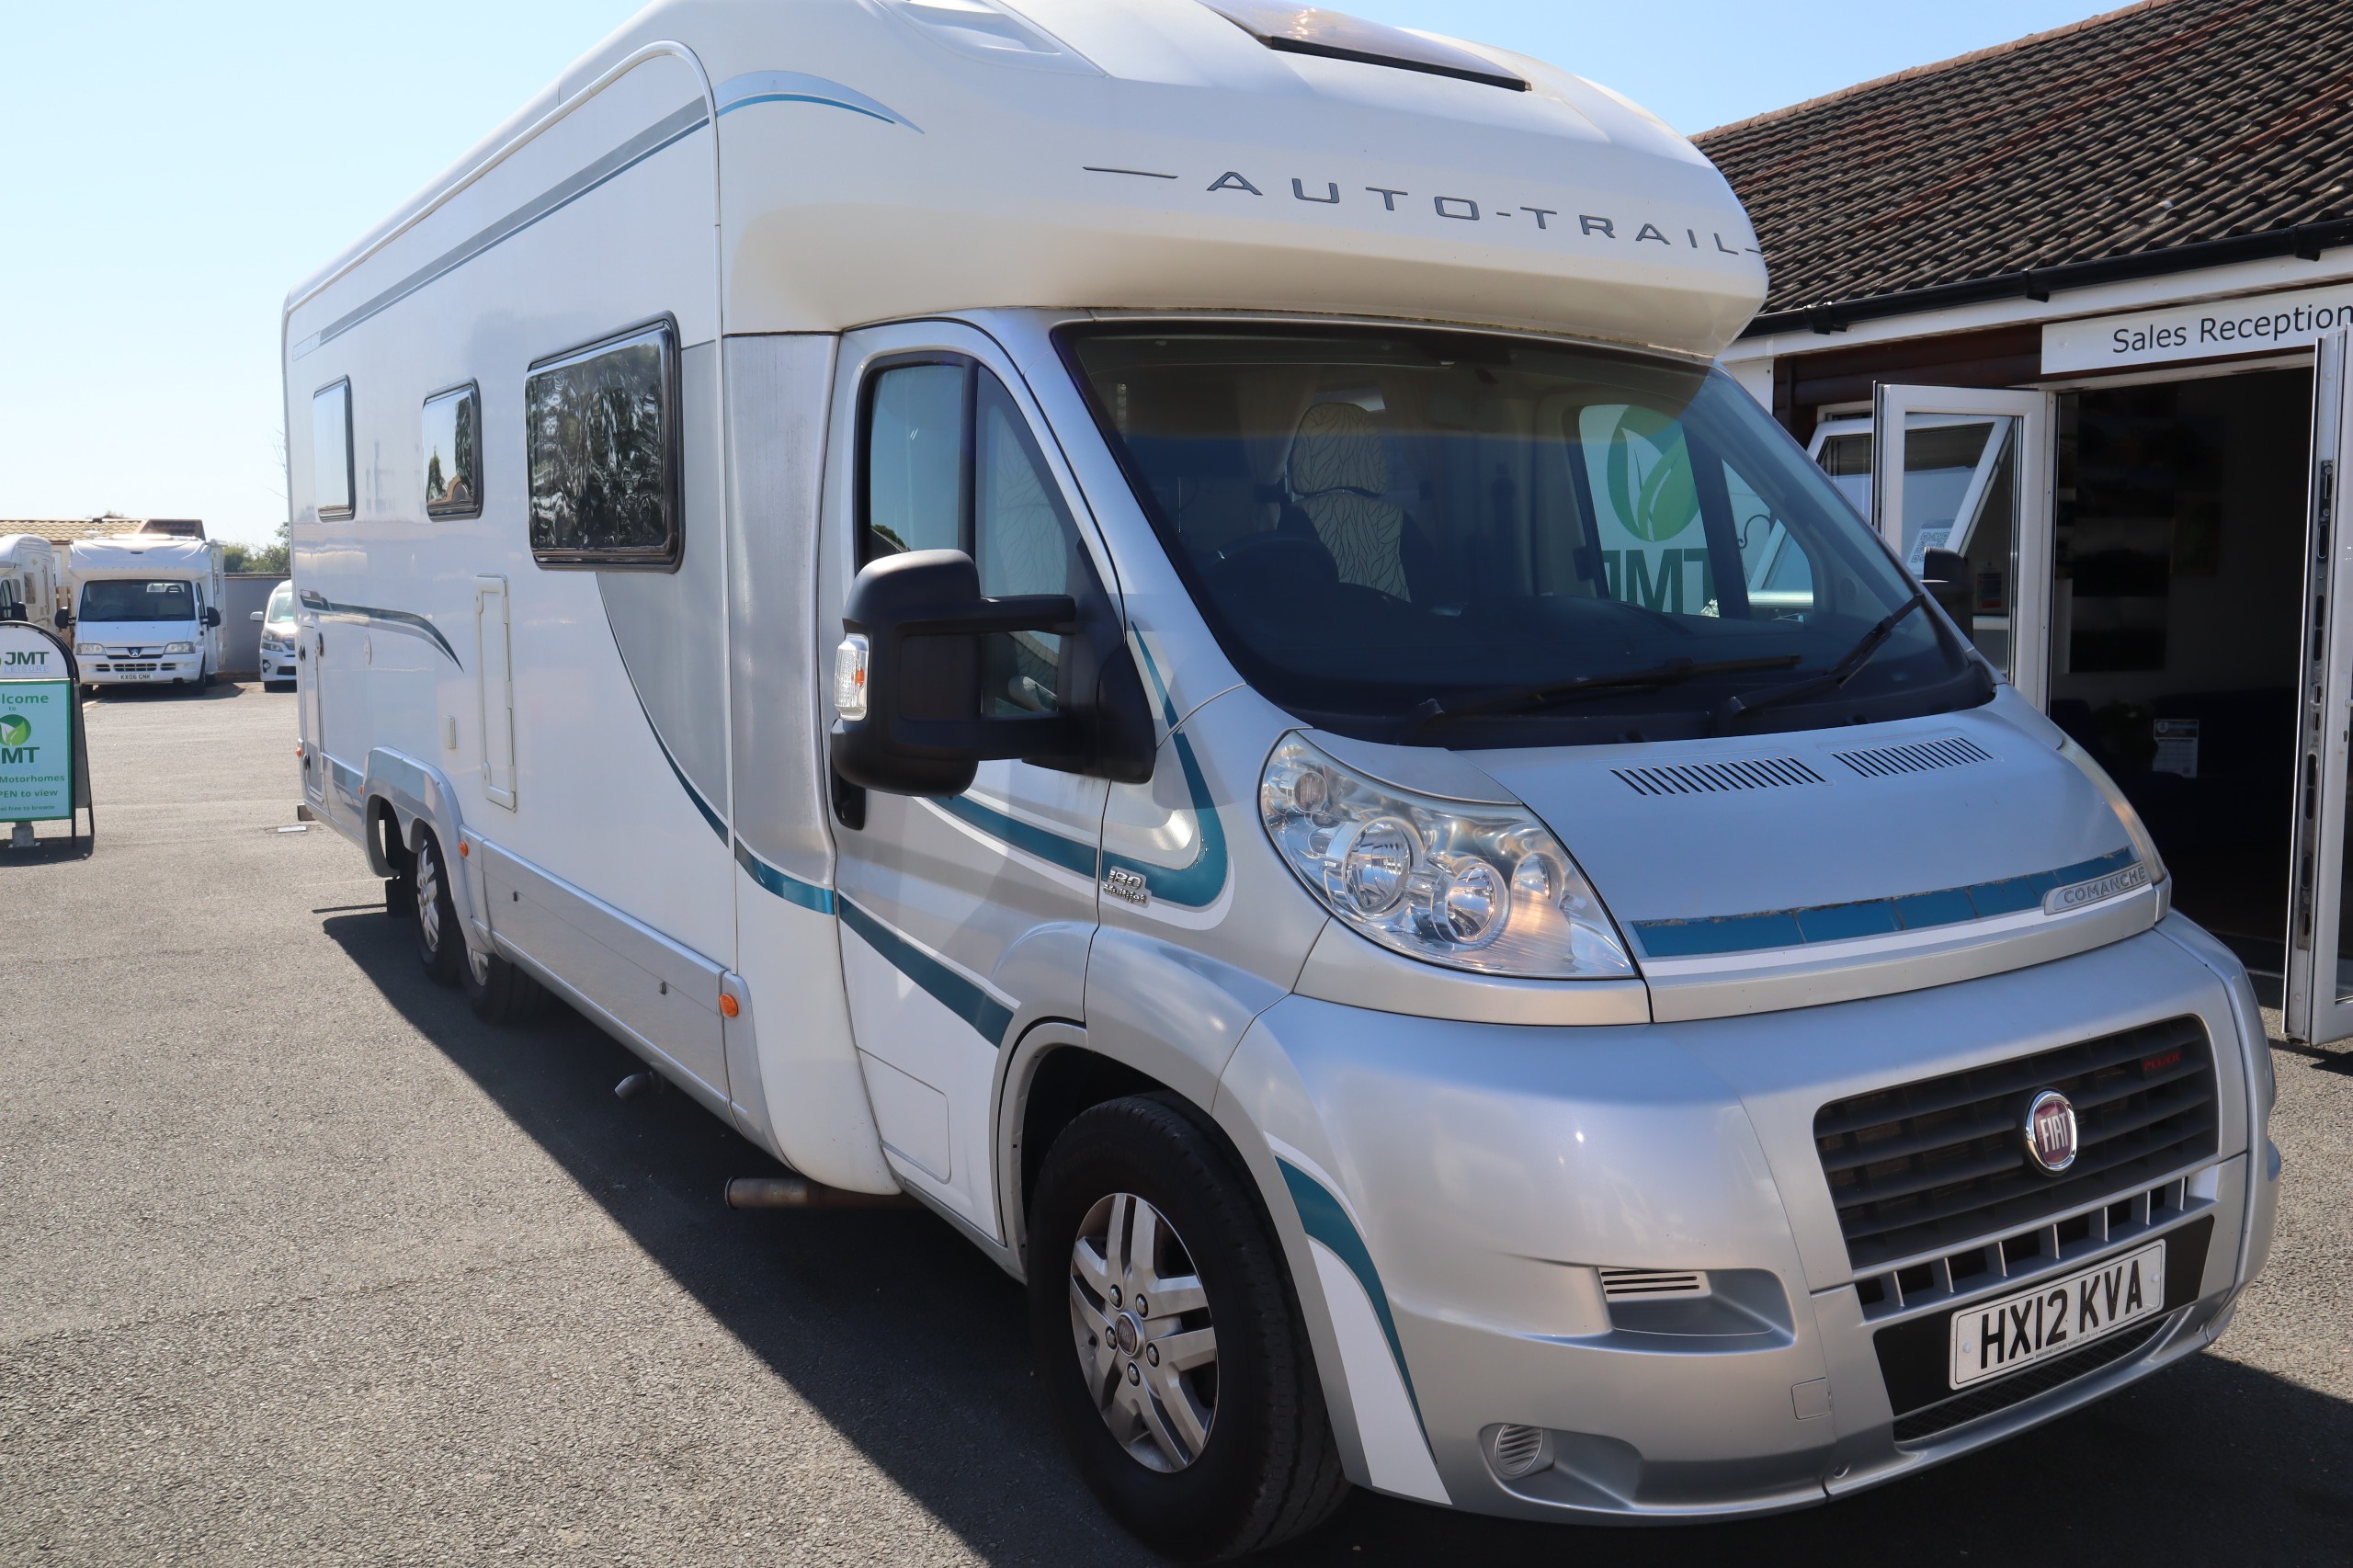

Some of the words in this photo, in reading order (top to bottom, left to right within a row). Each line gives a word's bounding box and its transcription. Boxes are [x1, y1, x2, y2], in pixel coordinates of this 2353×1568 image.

[2112, 324, 2188, 354] Sales
[2199, 304, 2353, 343] Reception
[4, 651, 50, 665] JMT
[0, 693, 49, 705] lcome
[0, 746, 40, 765] MT
[2063, 866, 2146, 903] COMANCHE
[2039, 1112, 2068, 1153] FIAT
[1980, 1289, 2068, 1369] HX12
[2078, 1259, 2143, 1334] KVA
